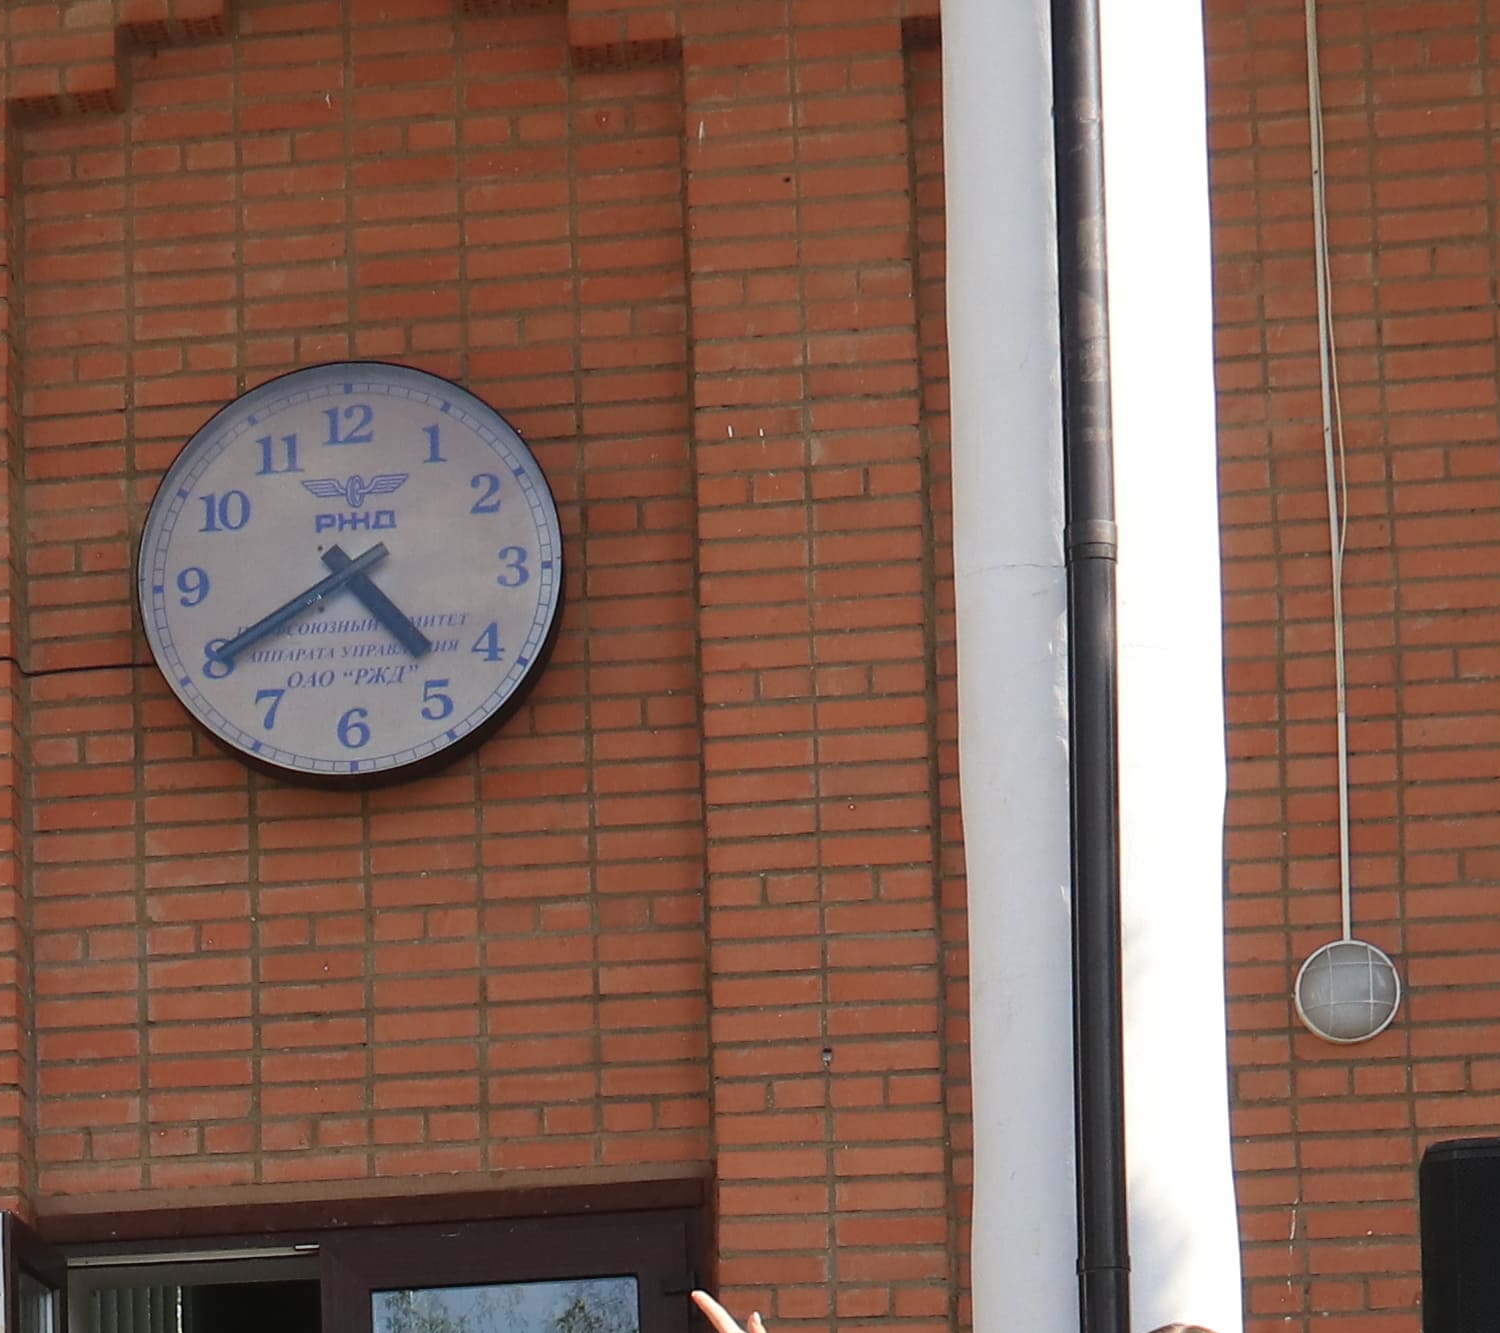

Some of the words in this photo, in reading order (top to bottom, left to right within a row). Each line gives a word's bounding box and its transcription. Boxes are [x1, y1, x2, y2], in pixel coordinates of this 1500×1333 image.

[322, 404, 374, 446] 12
[422, 424, 448, 464] 1
[255, 433, 305, 477] 11
[198, 489, 251, 533] 10
[469, 472, 502, 515] 2
[315, 509, 398, 534] РЖД
[176, 567, 210, 609] 9
[497, 546, 530, 588] 3
[408, 610, 470, 629] МИТЕТ
[202, 638, 236, 681] 8
[249, 648, 336, 664] АППАРАТА
[471, 622, 505, 664] 4
[287, 670, 335, 689] ОАО
[420, 679, 456, 721] 5
[254, 688, 286, 731] 7
[337, 708, 371, 749] 6
